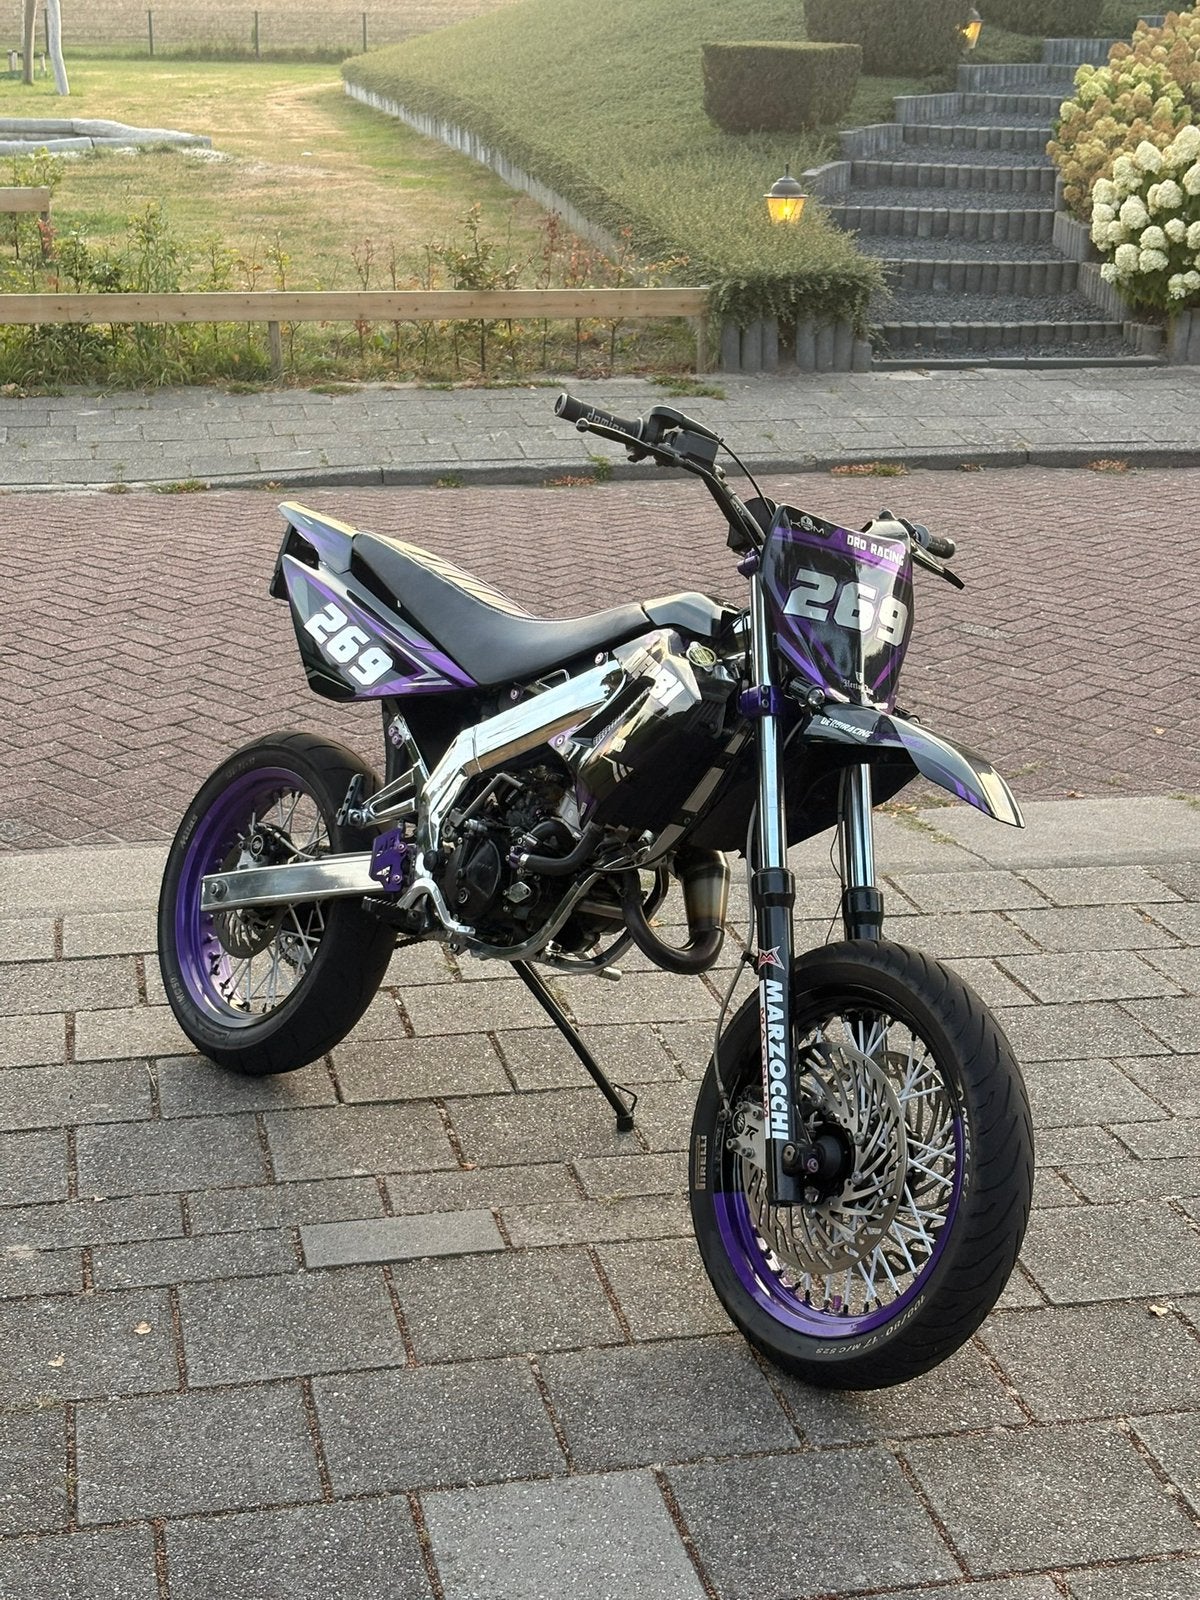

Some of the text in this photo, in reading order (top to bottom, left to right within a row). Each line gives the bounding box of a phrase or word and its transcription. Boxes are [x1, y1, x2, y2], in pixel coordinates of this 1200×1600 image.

[870, 543, 905, 567] RACING
[303, 602, 394, 686] 269
[783, 568, 909, 647] 269
[765, 978, 790, 1141] MARZOCCHI
[695, 1134, 707, 1190] PIRELLI
